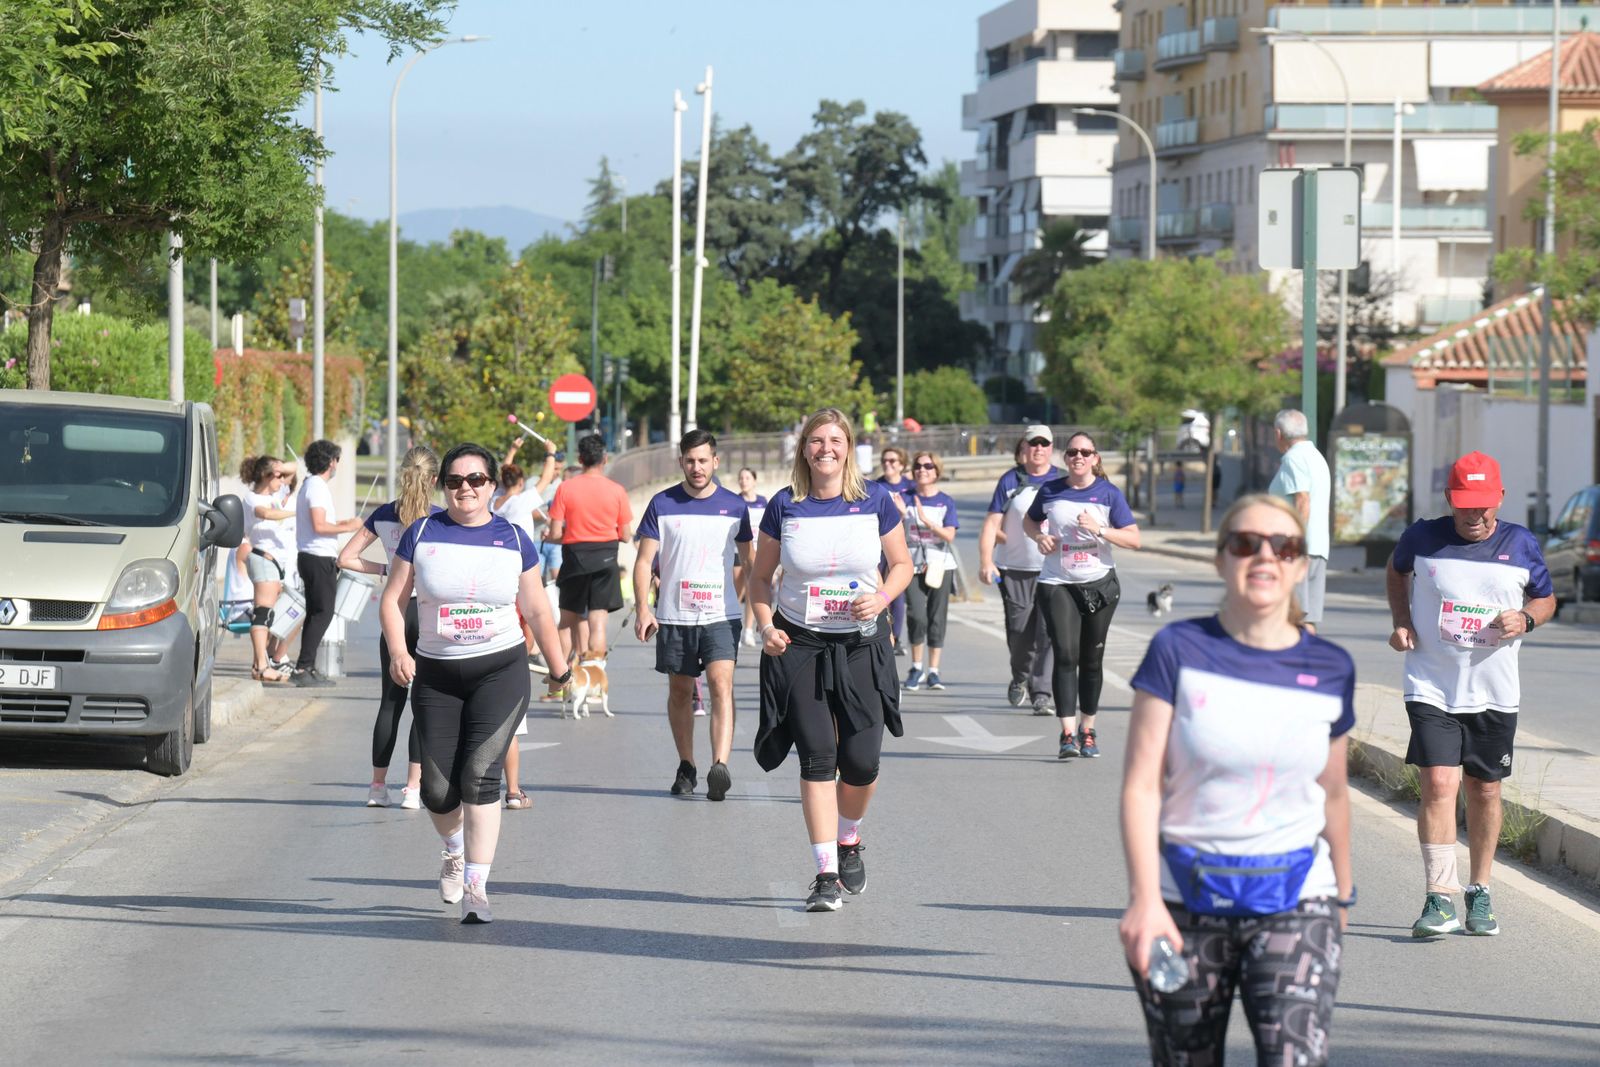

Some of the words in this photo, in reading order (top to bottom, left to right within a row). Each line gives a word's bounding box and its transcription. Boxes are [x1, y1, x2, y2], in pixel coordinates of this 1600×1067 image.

[1074, 552, 1088, 560] 635
[692, 591, 712, 600] 7088
[824, 599, 848, 611] 5312
[454, 617, 482, 630] 5309
[1461, 617, 1482, 630] 729
[20, 669, 50, 686] DJF
